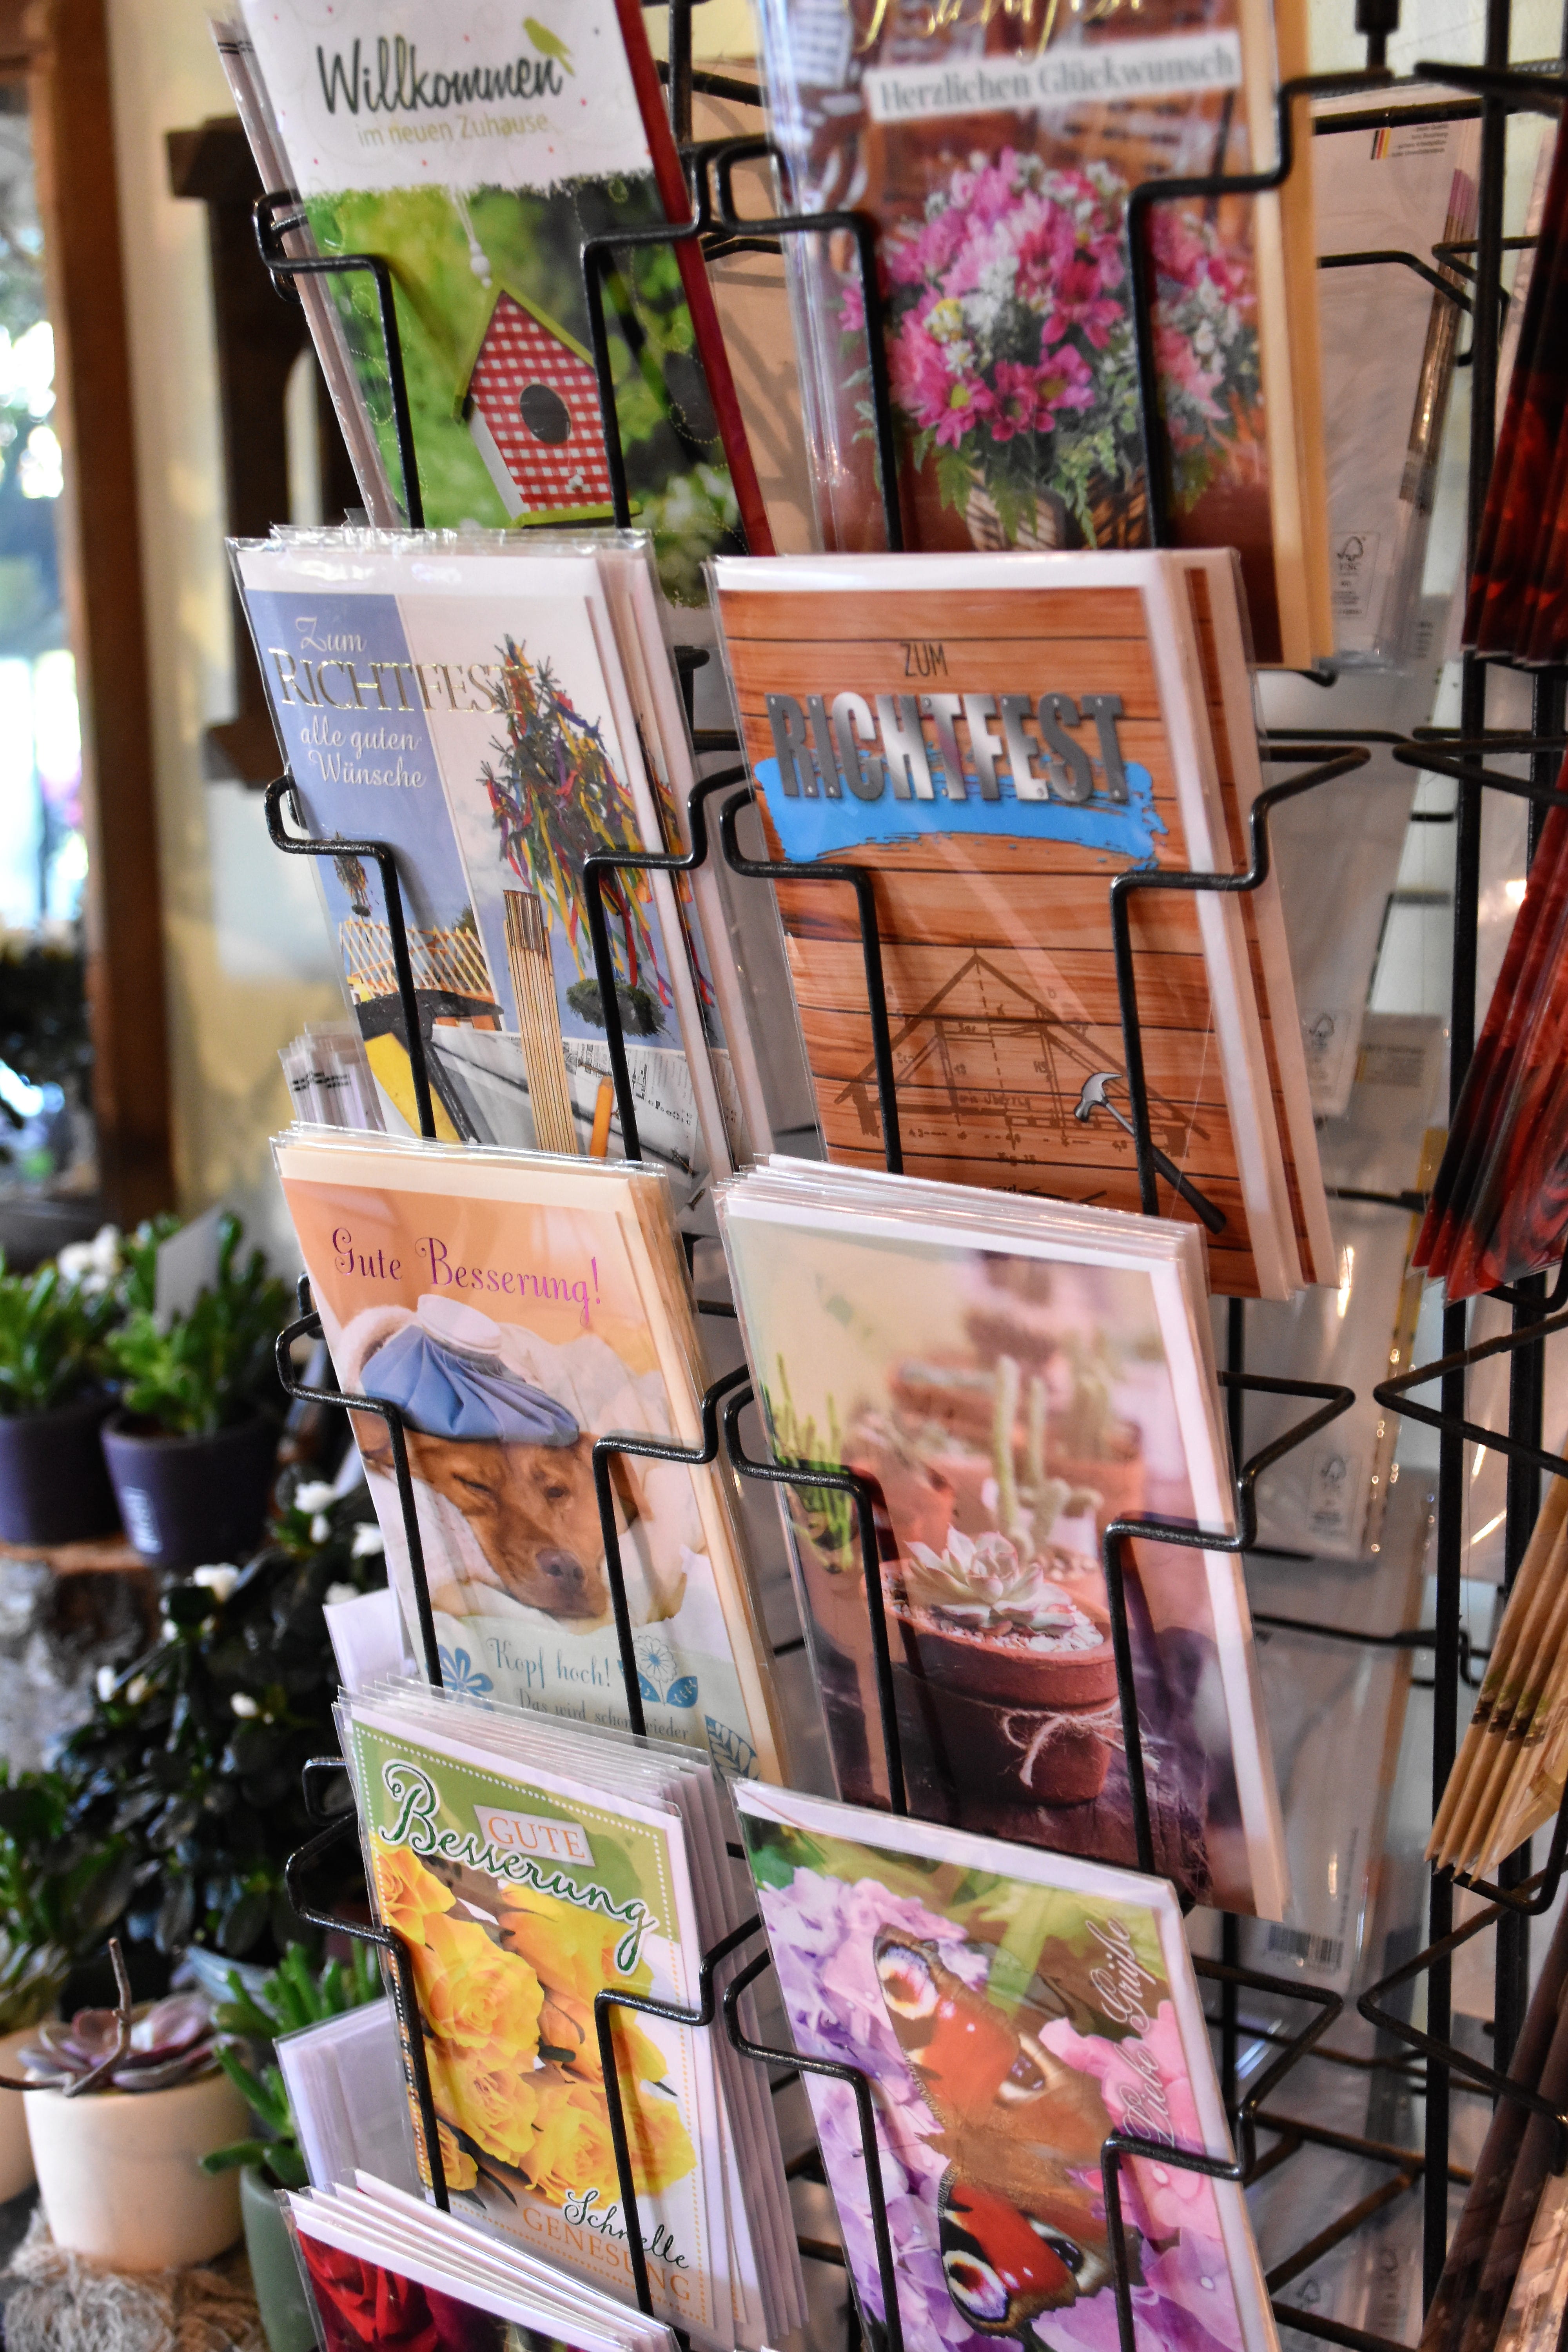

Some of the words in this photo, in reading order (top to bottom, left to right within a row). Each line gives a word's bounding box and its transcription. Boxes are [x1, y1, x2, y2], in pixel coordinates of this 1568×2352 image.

[318, 34, 562, 114] Willkommen
[880, 71, 1030, 109] Herzlichen
[1040, 44, 1234, 96] Glückwunsch
[356, 123, 383, 147] im
[388, 122, 452, 144] neuen
[459, 114, 547, 139] Zuhause
[296, 616, 367, 652] Zum
[901, 642, 949, 677] ZUM
[269, 648, 522, 714] RICHTFEST
[301, 715, 346, 747] alle
[350, 727, 422, 760] guten
[765, 691, 1130, 804] RICHTFEST
[308, 750, 426, 788] Wünsche
[332, 1227, 403, 1281] Gute
[415, 1237, 601, 1328] Besserung!
[485, 1637, 545, 1689] Kopf
[556, 1649, 611, 1688] hoch!
[517, 1688, 547, 1714] Das
[555, 1700, 586, 1720] wird
[645, 1717, 689, 1740] ieder
[381, 1763, 658, 1971] Besserung
[488, 1817, 585, 1859] GUTE
[1085, 1917, 1156, 2033] Grüße
[1112, 2042, 1175, 2147] Liebe
